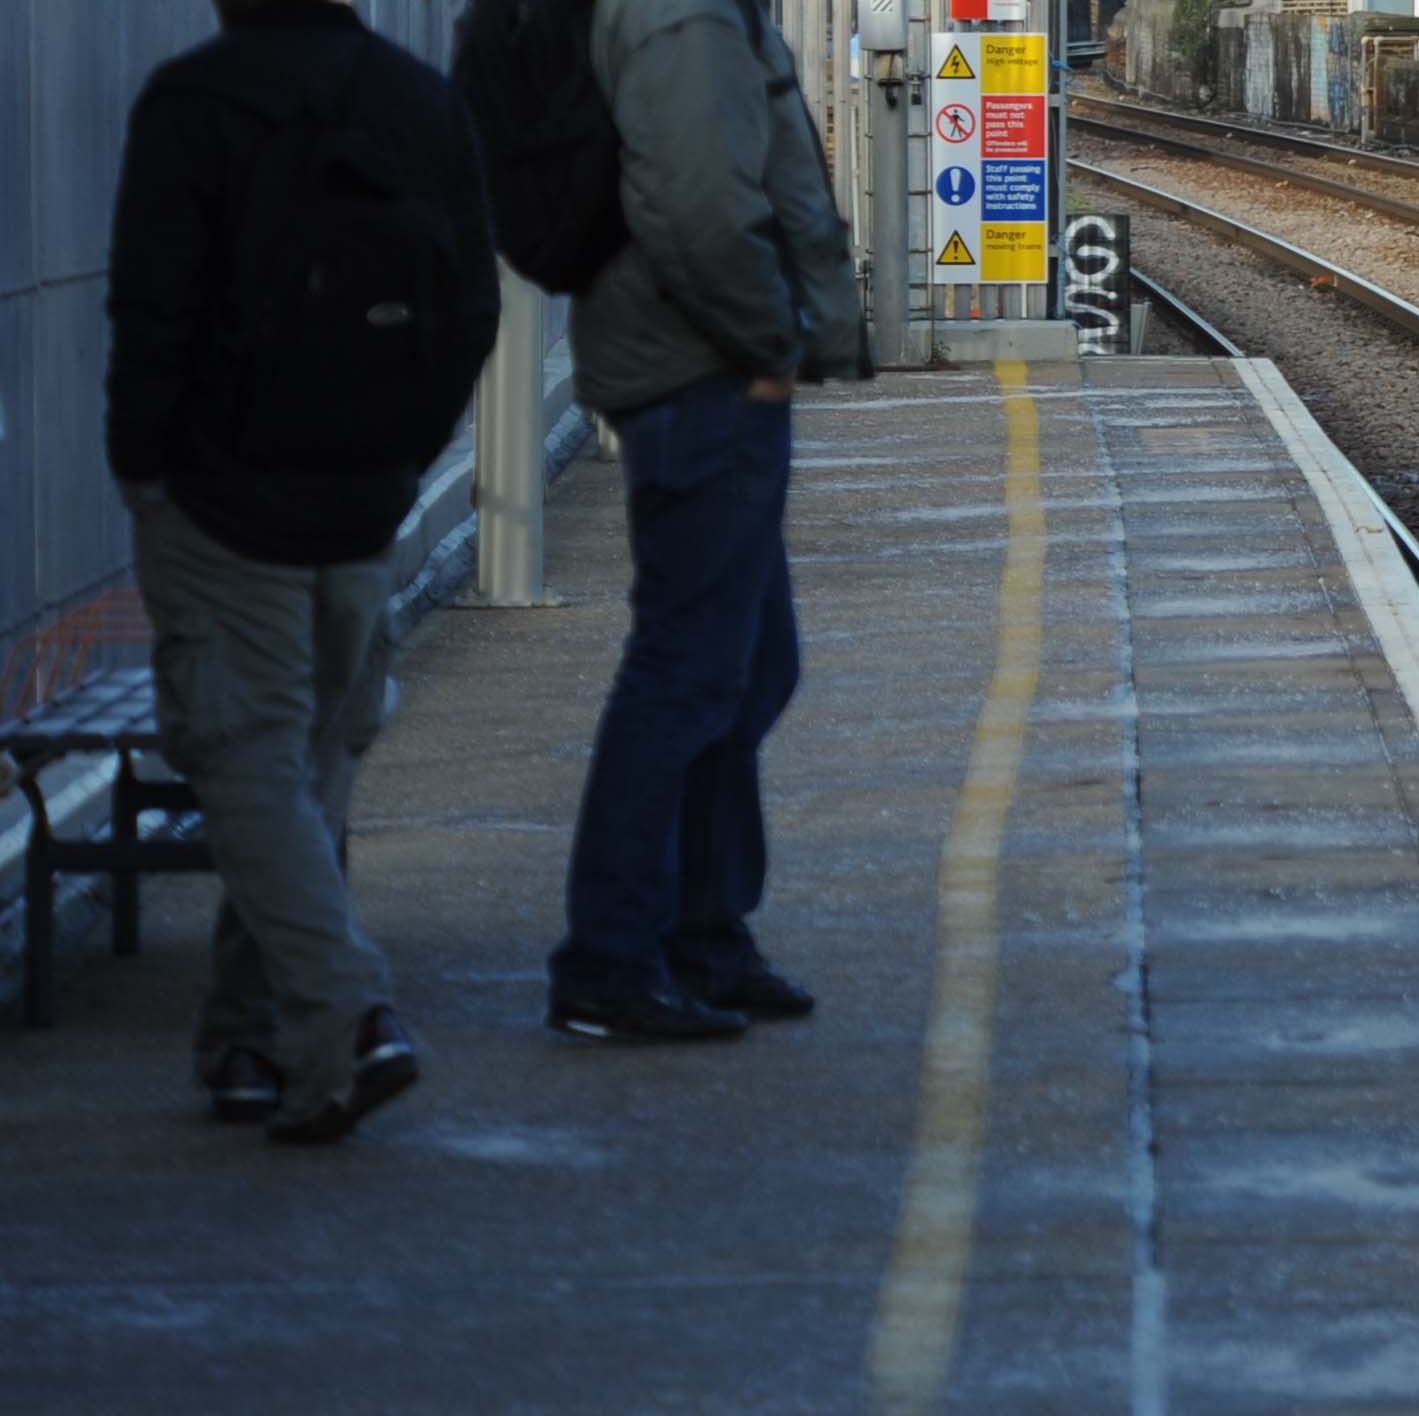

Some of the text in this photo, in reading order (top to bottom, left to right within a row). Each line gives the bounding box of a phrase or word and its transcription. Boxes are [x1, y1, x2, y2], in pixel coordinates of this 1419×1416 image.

[986, 44, 1027, 57] Danger
[986, 101, 1034, 111] Passengers
[986, 111, 1025, 120] must not
[986, 120, 1025, 131] pass this
[986, 130, 1009, 139] point
[986, 164, 1041, 175] Staff passing
[986, 174, 1027, 183] this point
[986, 184, 1041, 193] must comply
[986, 193, 1035, 203] with safety
[986, 203, 1037, 211] instructions
[986, 229, 1027, 242] Danger
